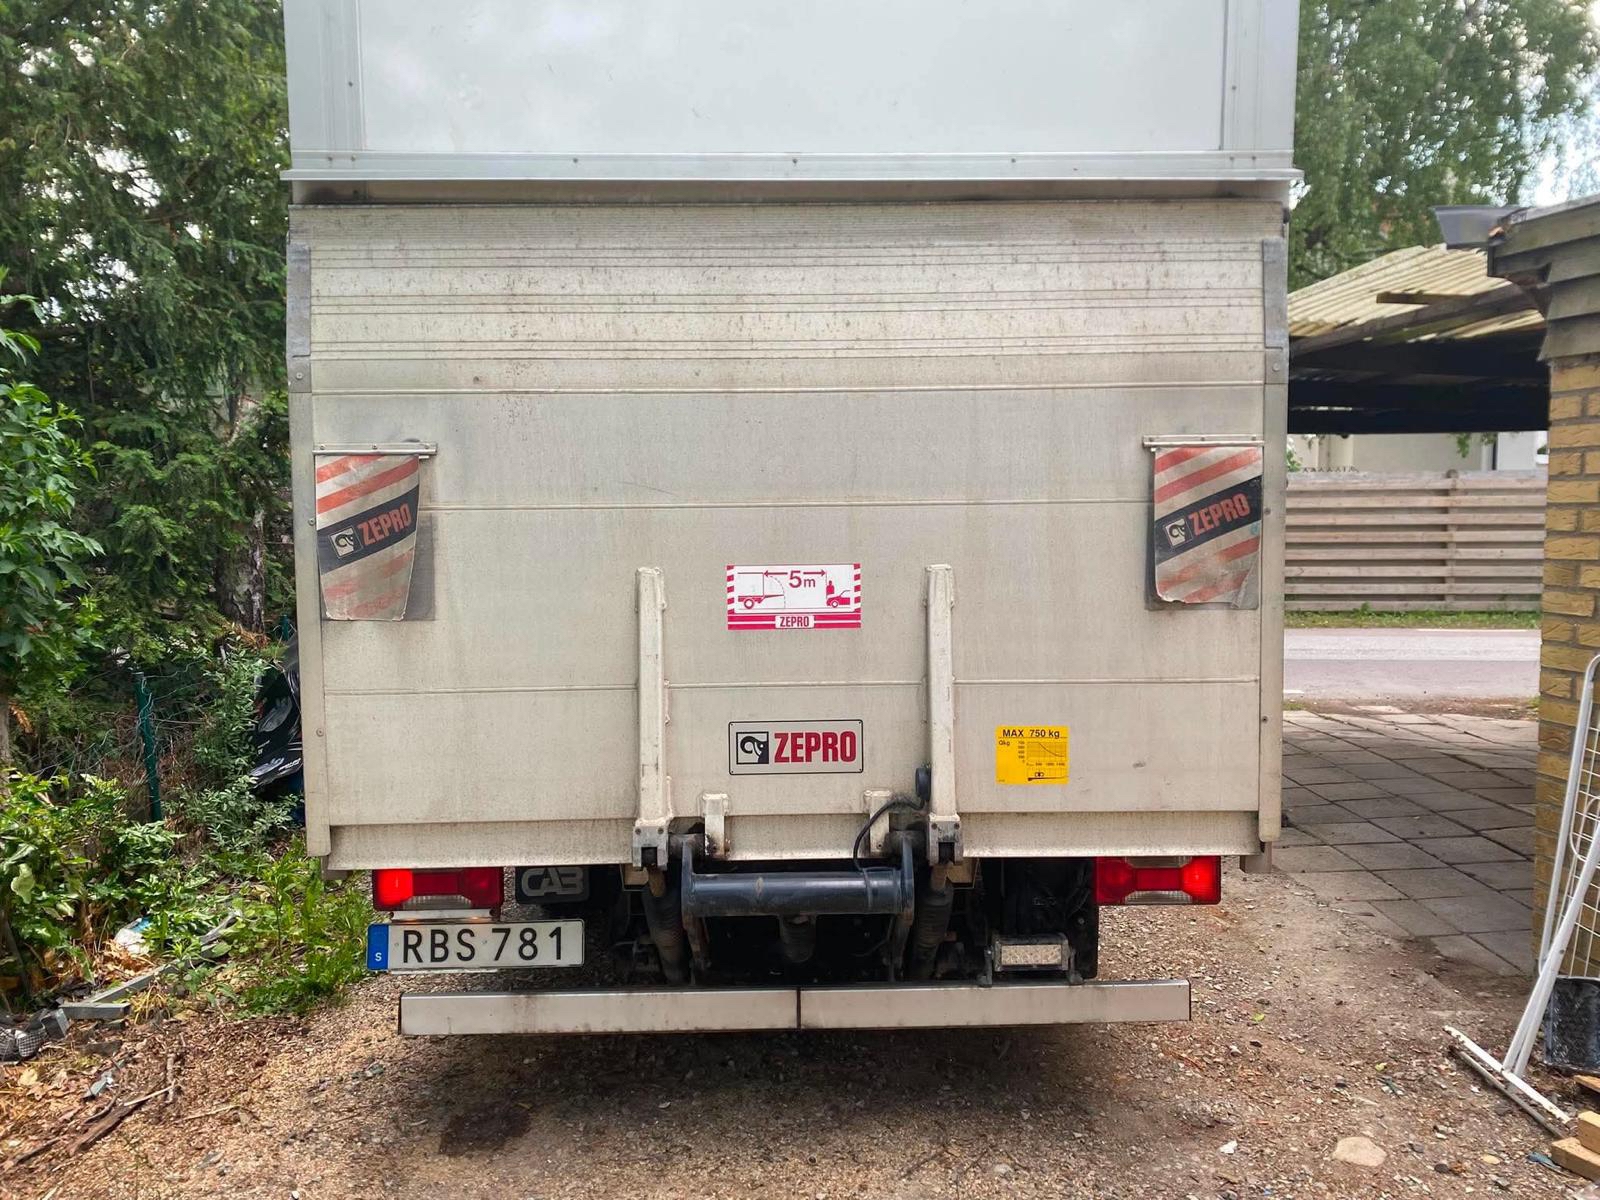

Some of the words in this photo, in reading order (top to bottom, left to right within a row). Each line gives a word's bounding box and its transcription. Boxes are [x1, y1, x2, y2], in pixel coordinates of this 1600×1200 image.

[357, 503, 412, 546] ZEPRO
[1188, 493, 1250, 536] ZEPRO
[779, 616, 809, 627] ZEPRO
[774, 731, 857, 763] ZEPRO
[1002, 729, 1024, 737] MAX
[1029, 729, 1046, 738] 750
[1048, 729, 1060, 740] kg
[374, 952, 383, 962] S
[402, 928, 476, 963] RBS
[491, 926, 563, 962] 781
